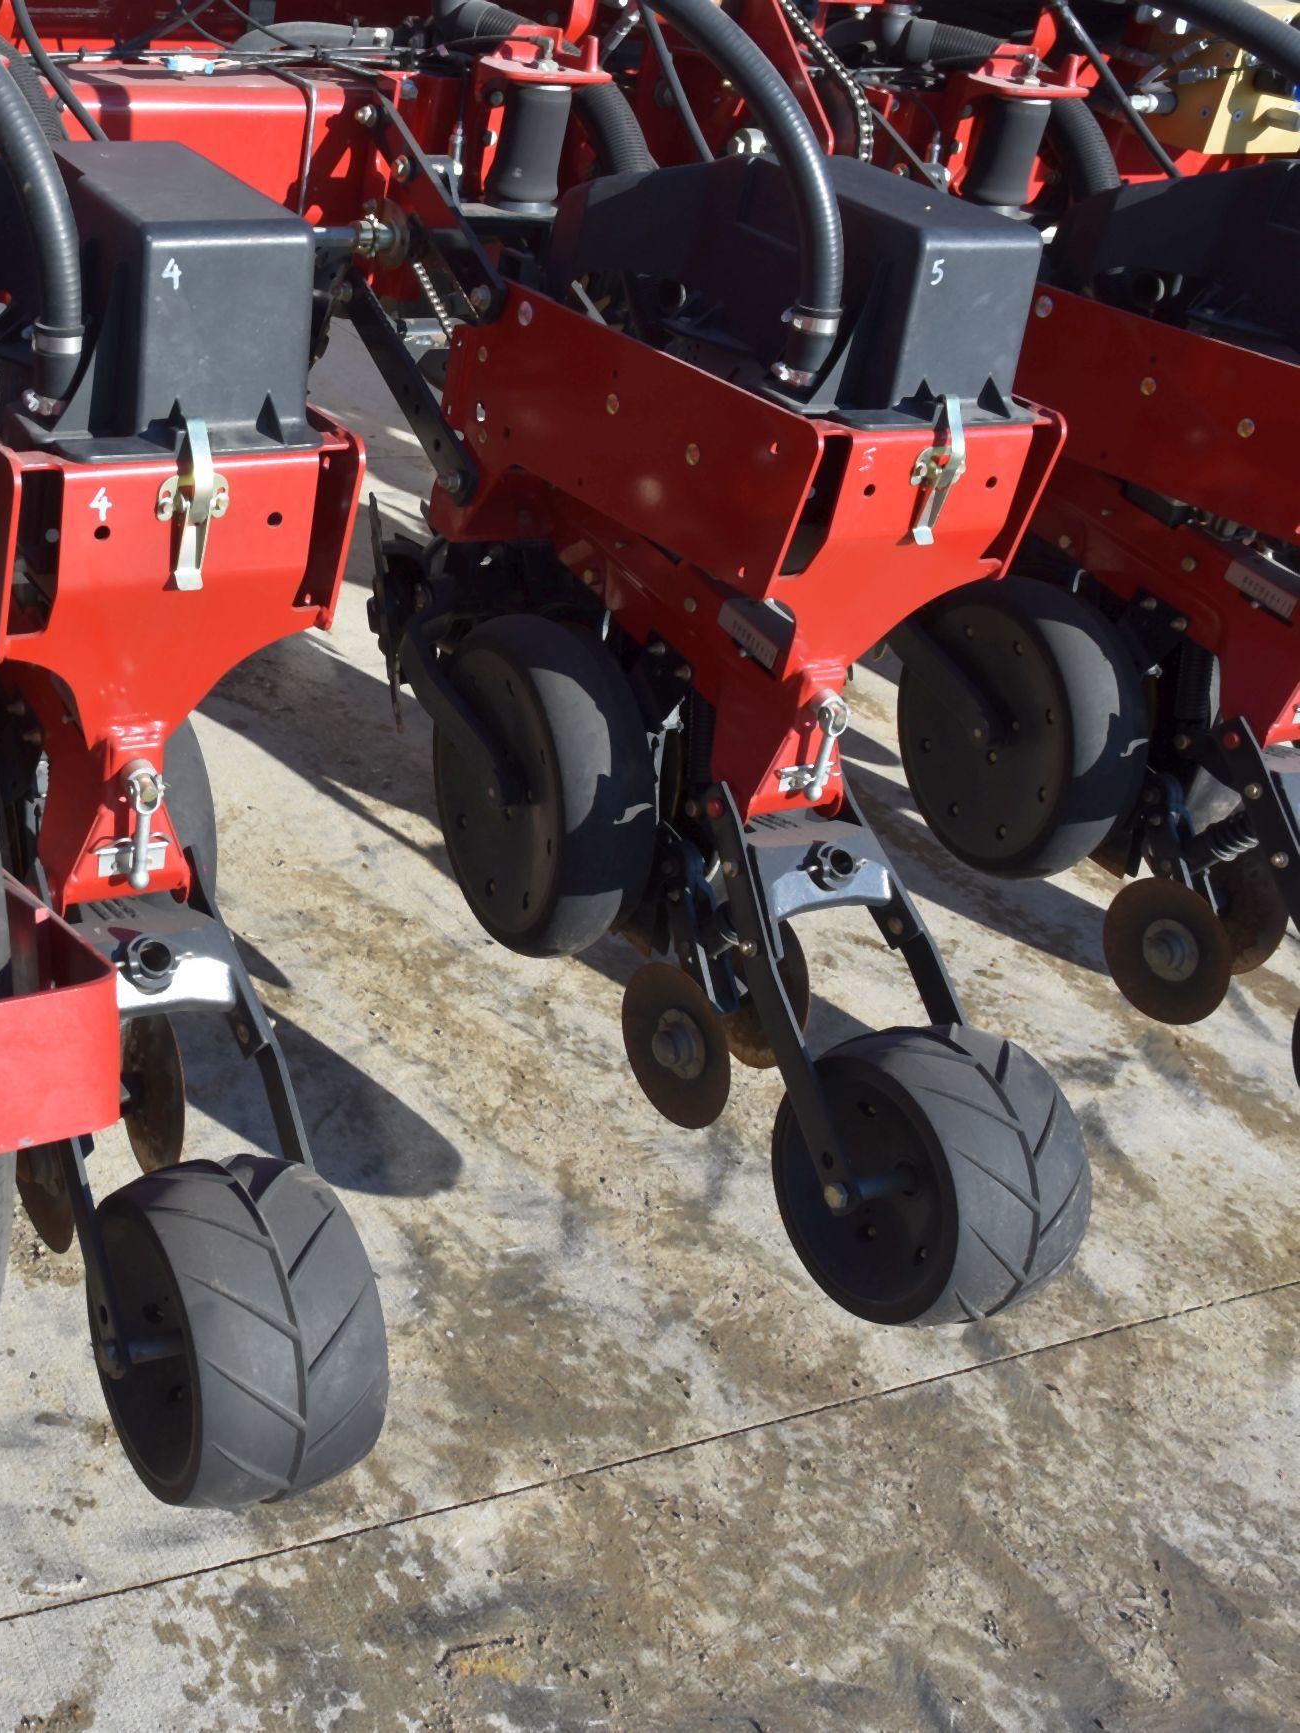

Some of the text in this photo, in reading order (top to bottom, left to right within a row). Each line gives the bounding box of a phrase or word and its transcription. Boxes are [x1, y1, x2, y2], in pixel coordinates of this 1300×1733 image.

[161, 258, 182, 290] 4
[930, 258, 945, 285] 5
[89, 486, 112, 522] 4
